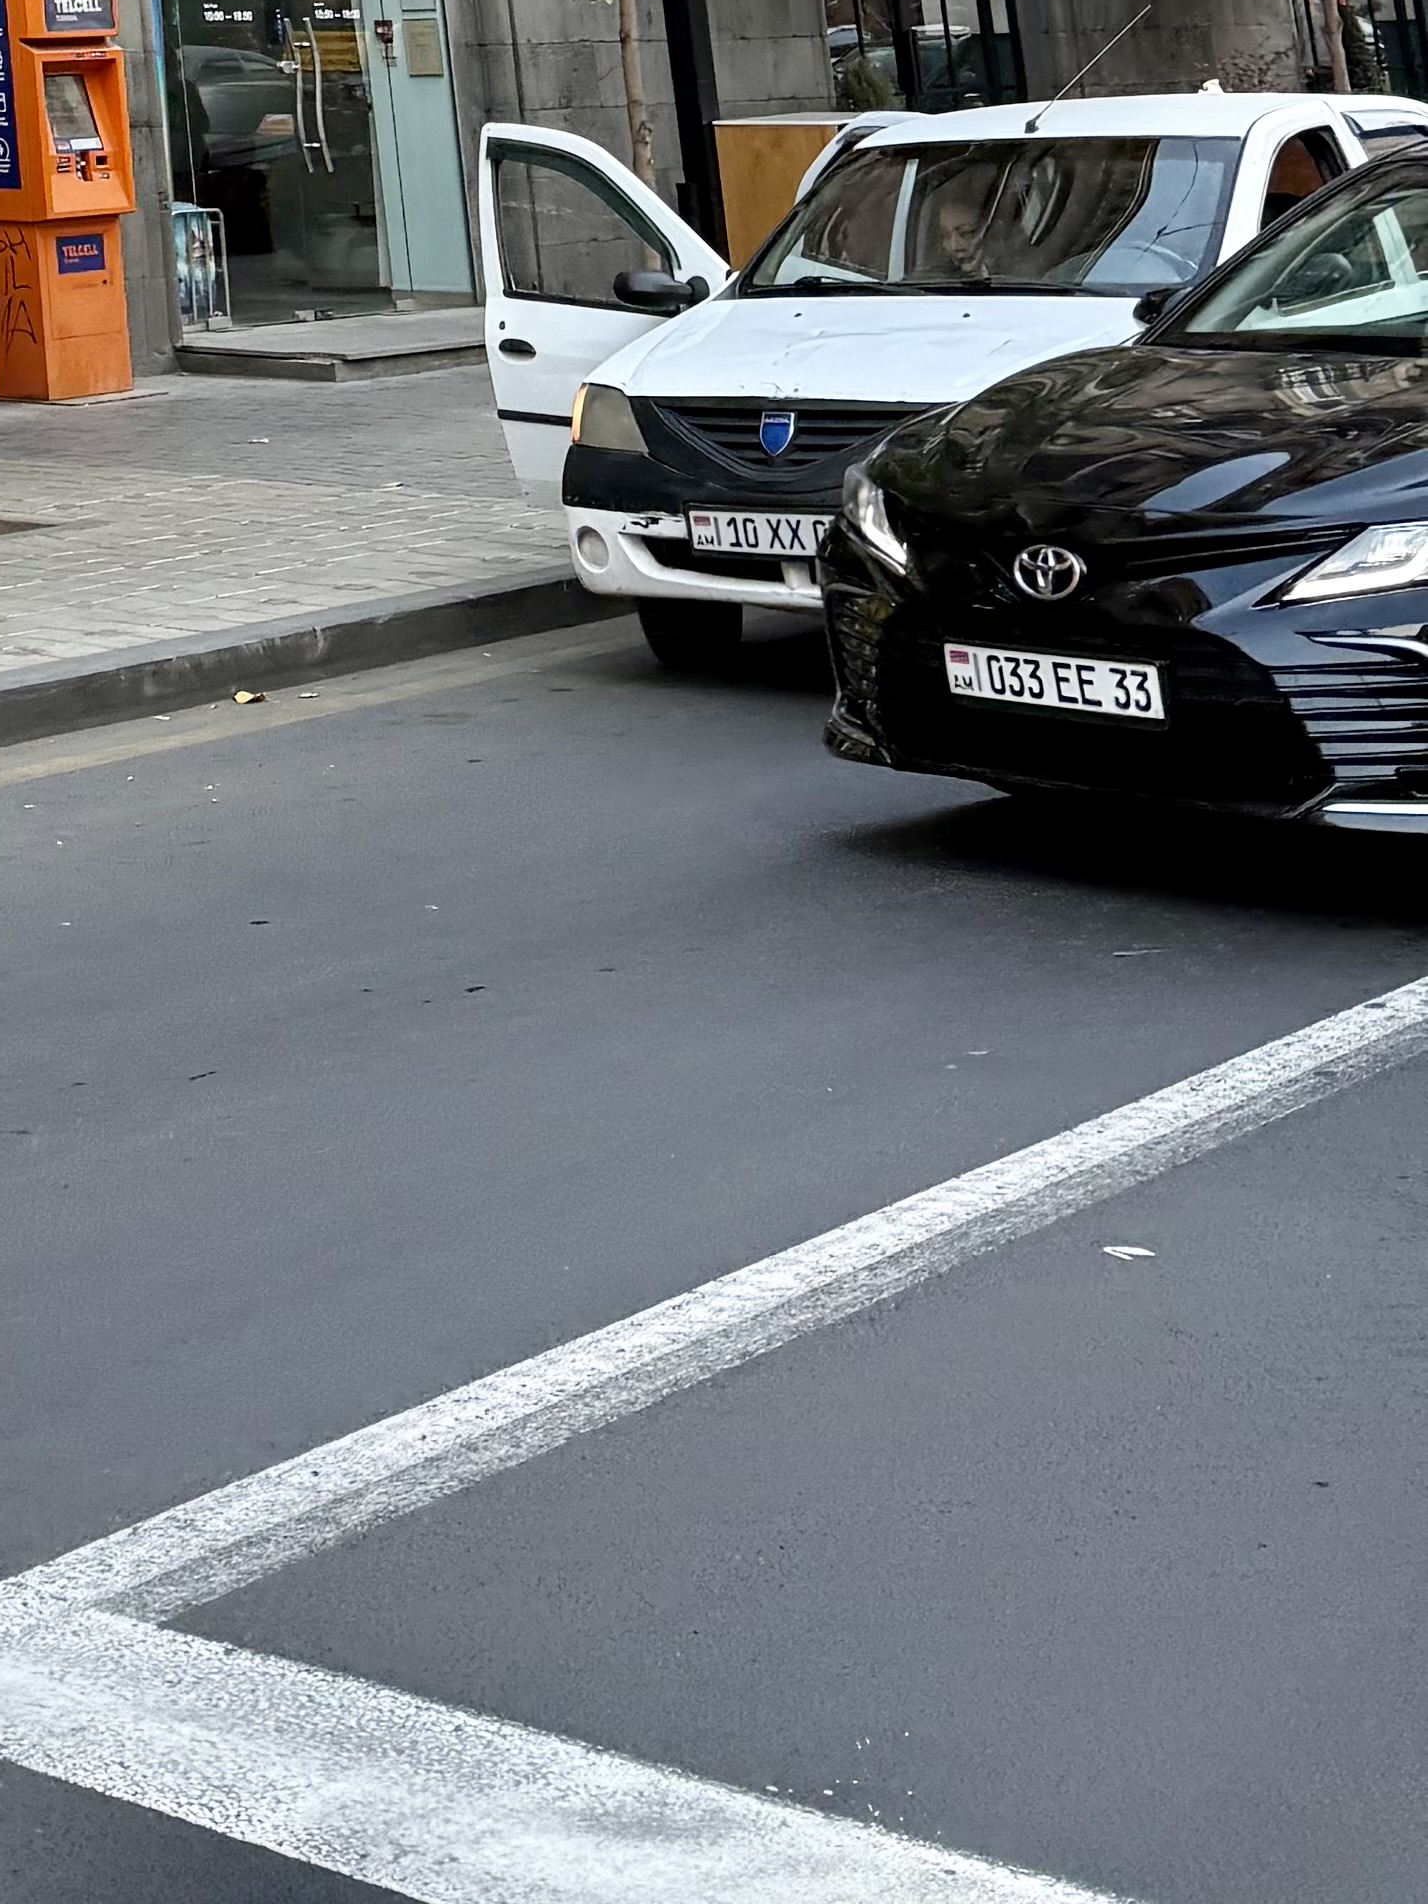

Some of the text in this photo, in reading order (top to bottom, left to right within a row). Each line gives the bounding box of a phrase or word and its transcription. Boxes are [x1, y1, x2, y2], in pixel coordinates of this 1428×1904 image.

[727, 517, 759, 548] 10
[766, 518, 806, 550] XX
[987, 654, 1044, 700] 033
[1052, 661, 1103, 707] EE
[1109, 667, 1152, 712] 33
